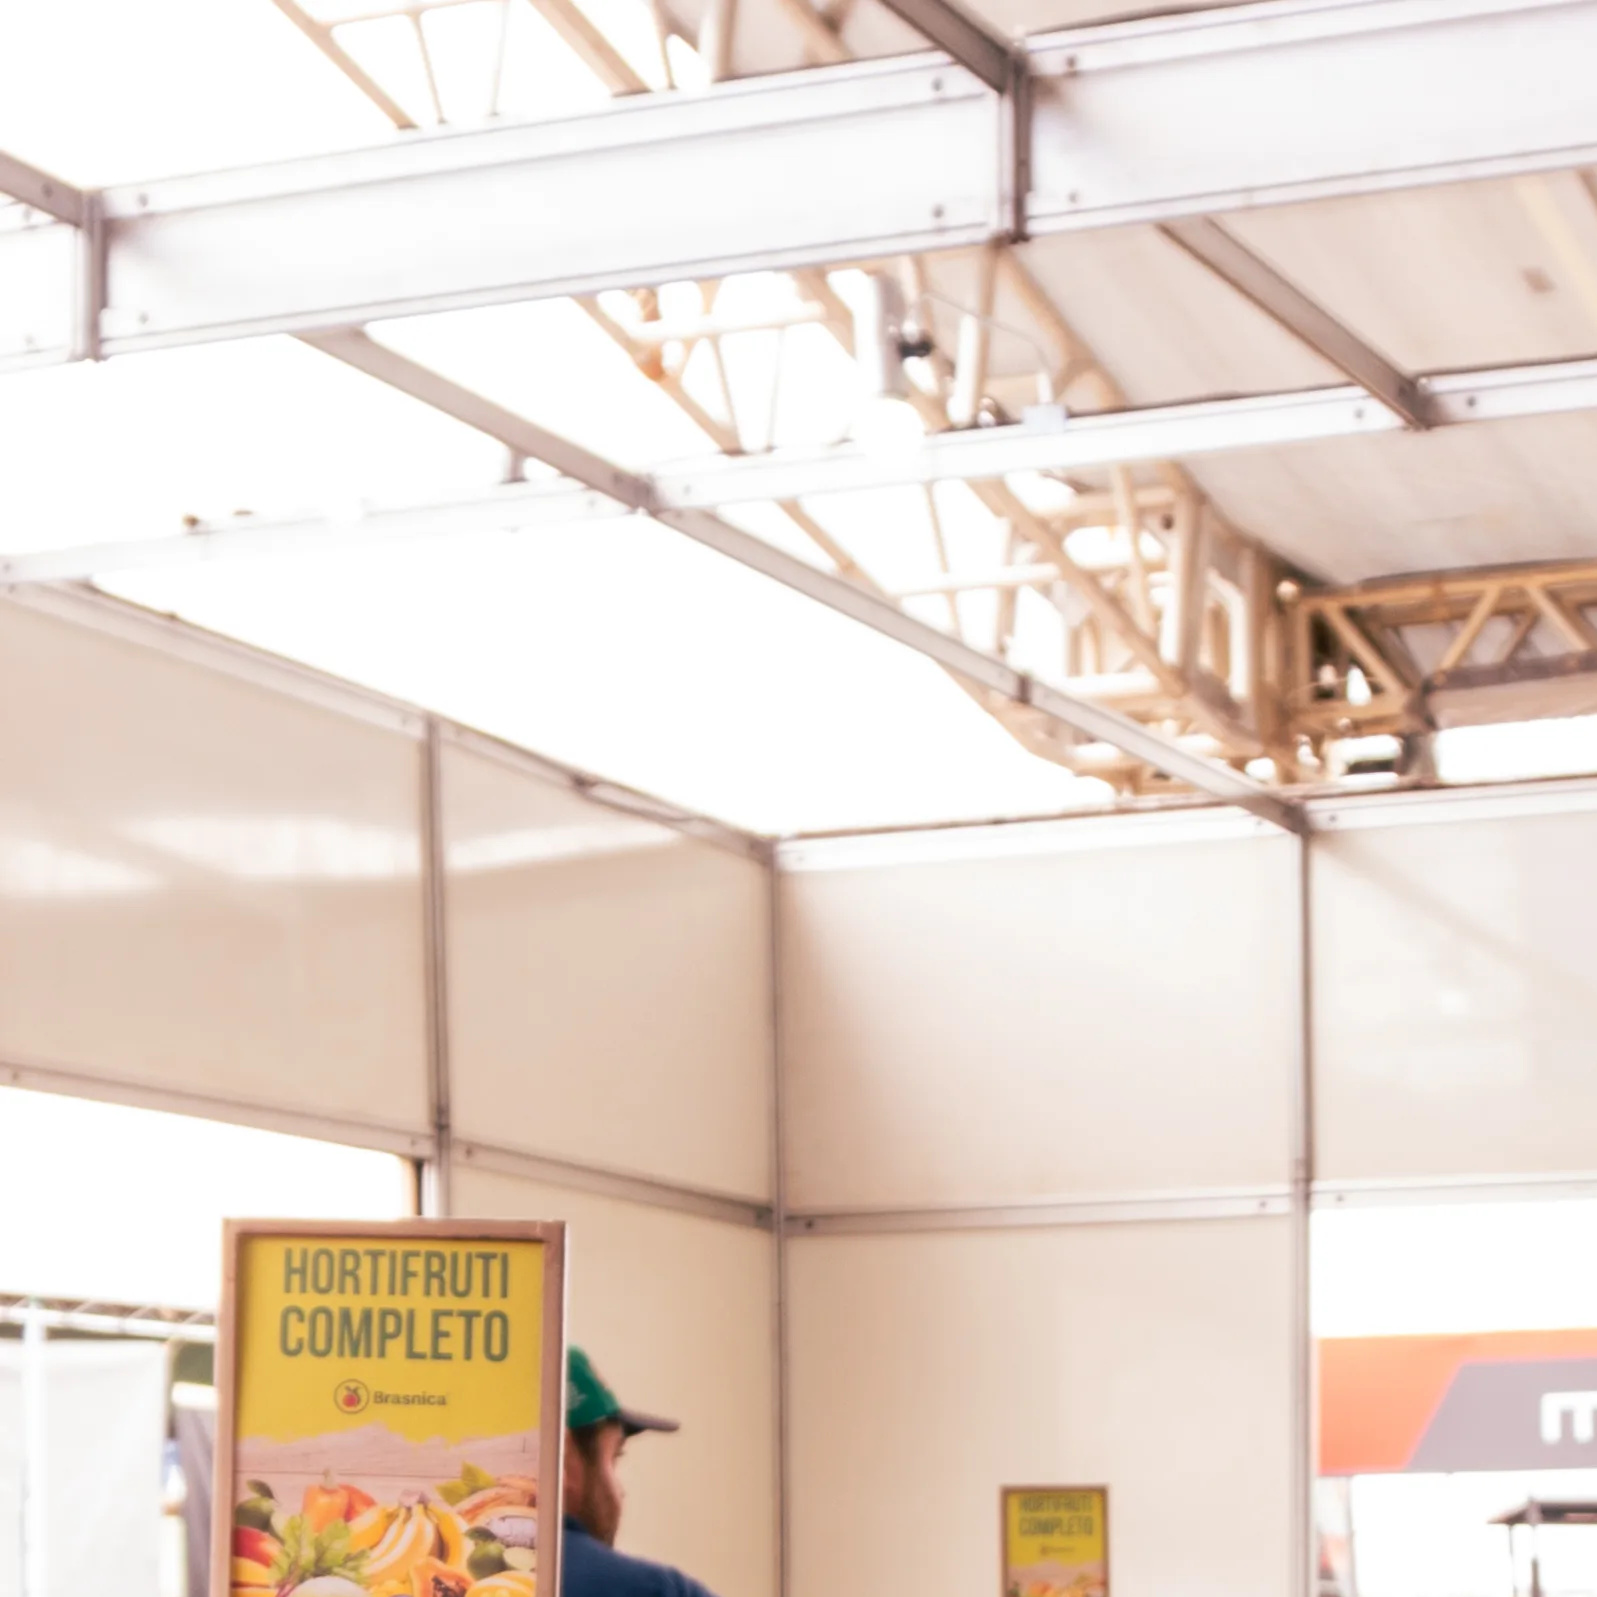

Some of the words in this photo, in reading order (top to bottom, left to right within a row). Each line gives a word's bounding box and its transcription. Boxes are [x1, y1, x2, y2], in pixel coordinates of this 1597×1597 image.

[283, 1247, 510, 1299] HORTIFRUTI
[279, 1305, 511, 1363] COMPLETO
[373, 1389, 448, 1407] Brasnica
